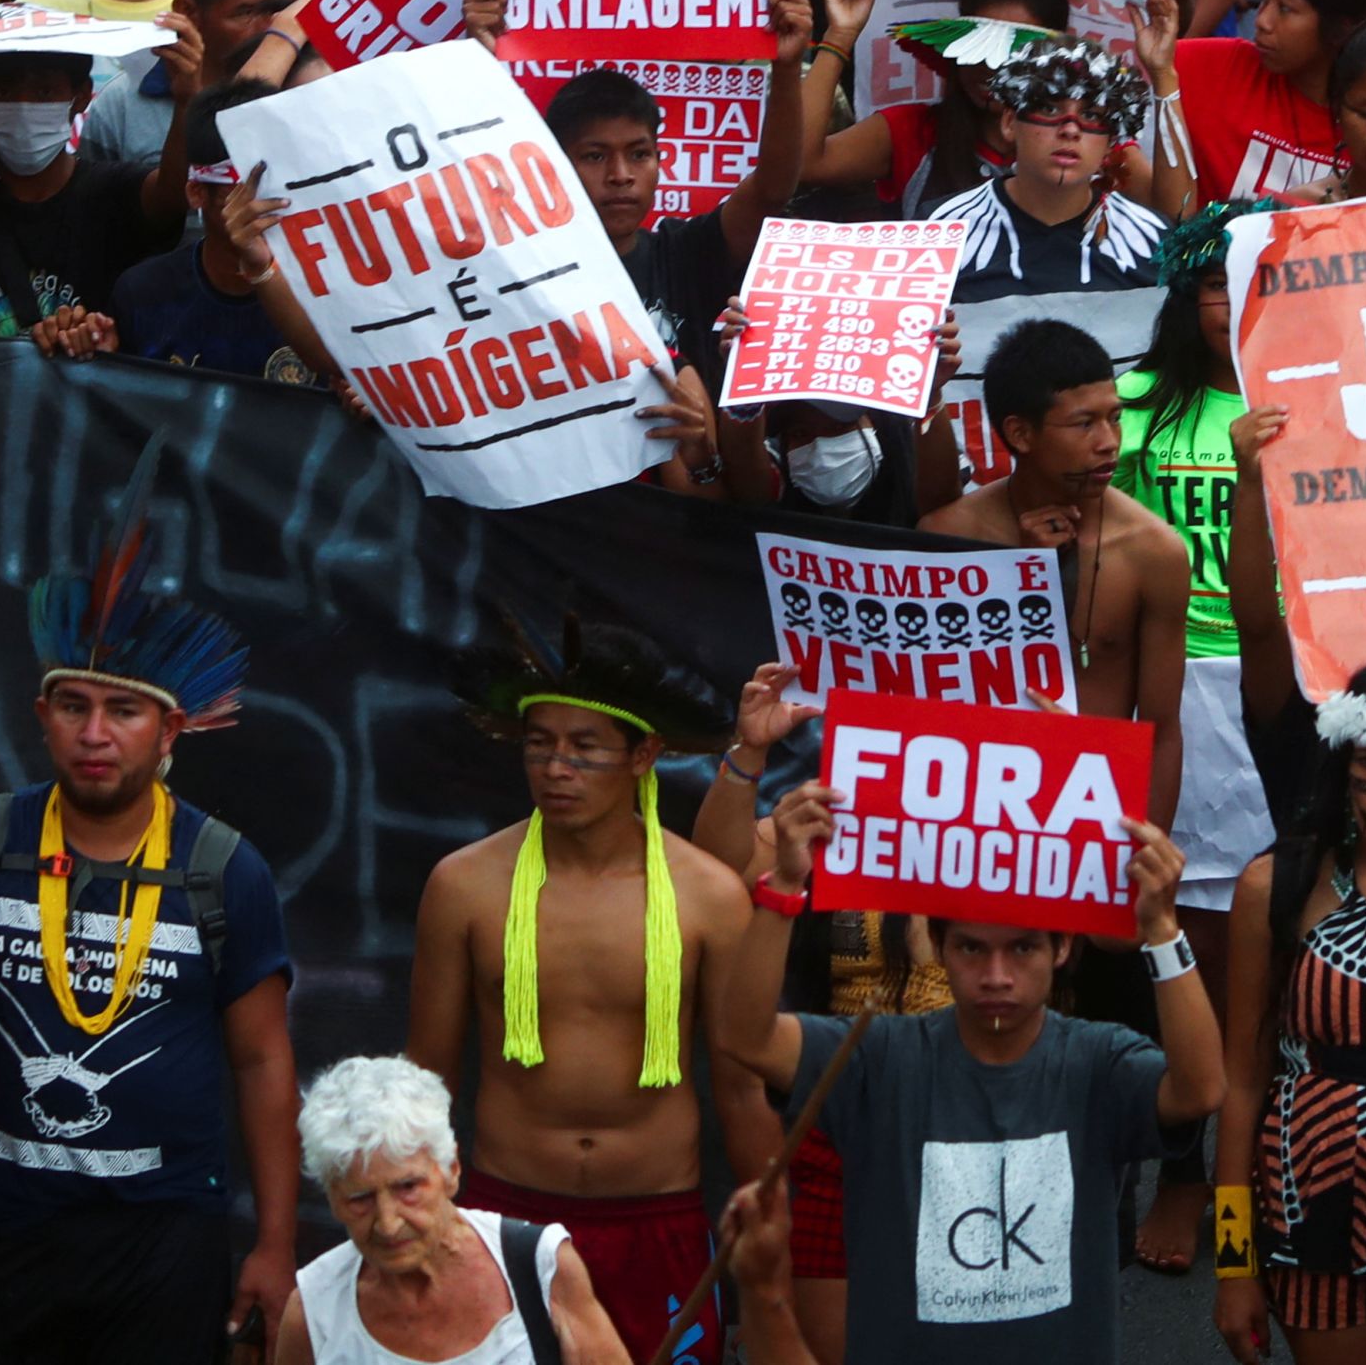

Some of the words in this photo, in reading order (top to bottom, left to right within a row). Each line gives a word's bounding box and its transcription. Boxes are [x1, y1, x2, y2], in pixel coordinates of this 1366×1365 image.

[686, 101, 752, 140] DA
[387, 122, 429, 172] O
[658, 142, 758, 184] RTE:
[287, 140, 575, 298] FUTURO
[873, 248, 948, 275] DA
[451, 267, 491, 322] É
[754, 265, 950, 302] MORTE:
[775, 315, 815, 333] PL
[822, 316, 875, 335] 490
[778, 296, 817, 315] PL
[827, 298, 869, 316] 191
[351, 301, 659, 429] INDÍGENA
[765, 352, 806, 372] PL
[813, 353, 862, 373] 510
[770, 334, 812, 352] PL
[818, 334, 890, 356] 2633
[761, 373, 802, 393] PL
[809, 373, 875, 396] 2156
[766, 545, 988, 600] GARIMPO
[1016, 553, 1049, 592] É
[779, 629, 1067, 708] VENENO
[832, 724, 1131, 843] FORA
[822, 811, 1133, 906] GENOCIDA!
[1, 958, 13, 978] É
[17, 964, 44, 985] DE
